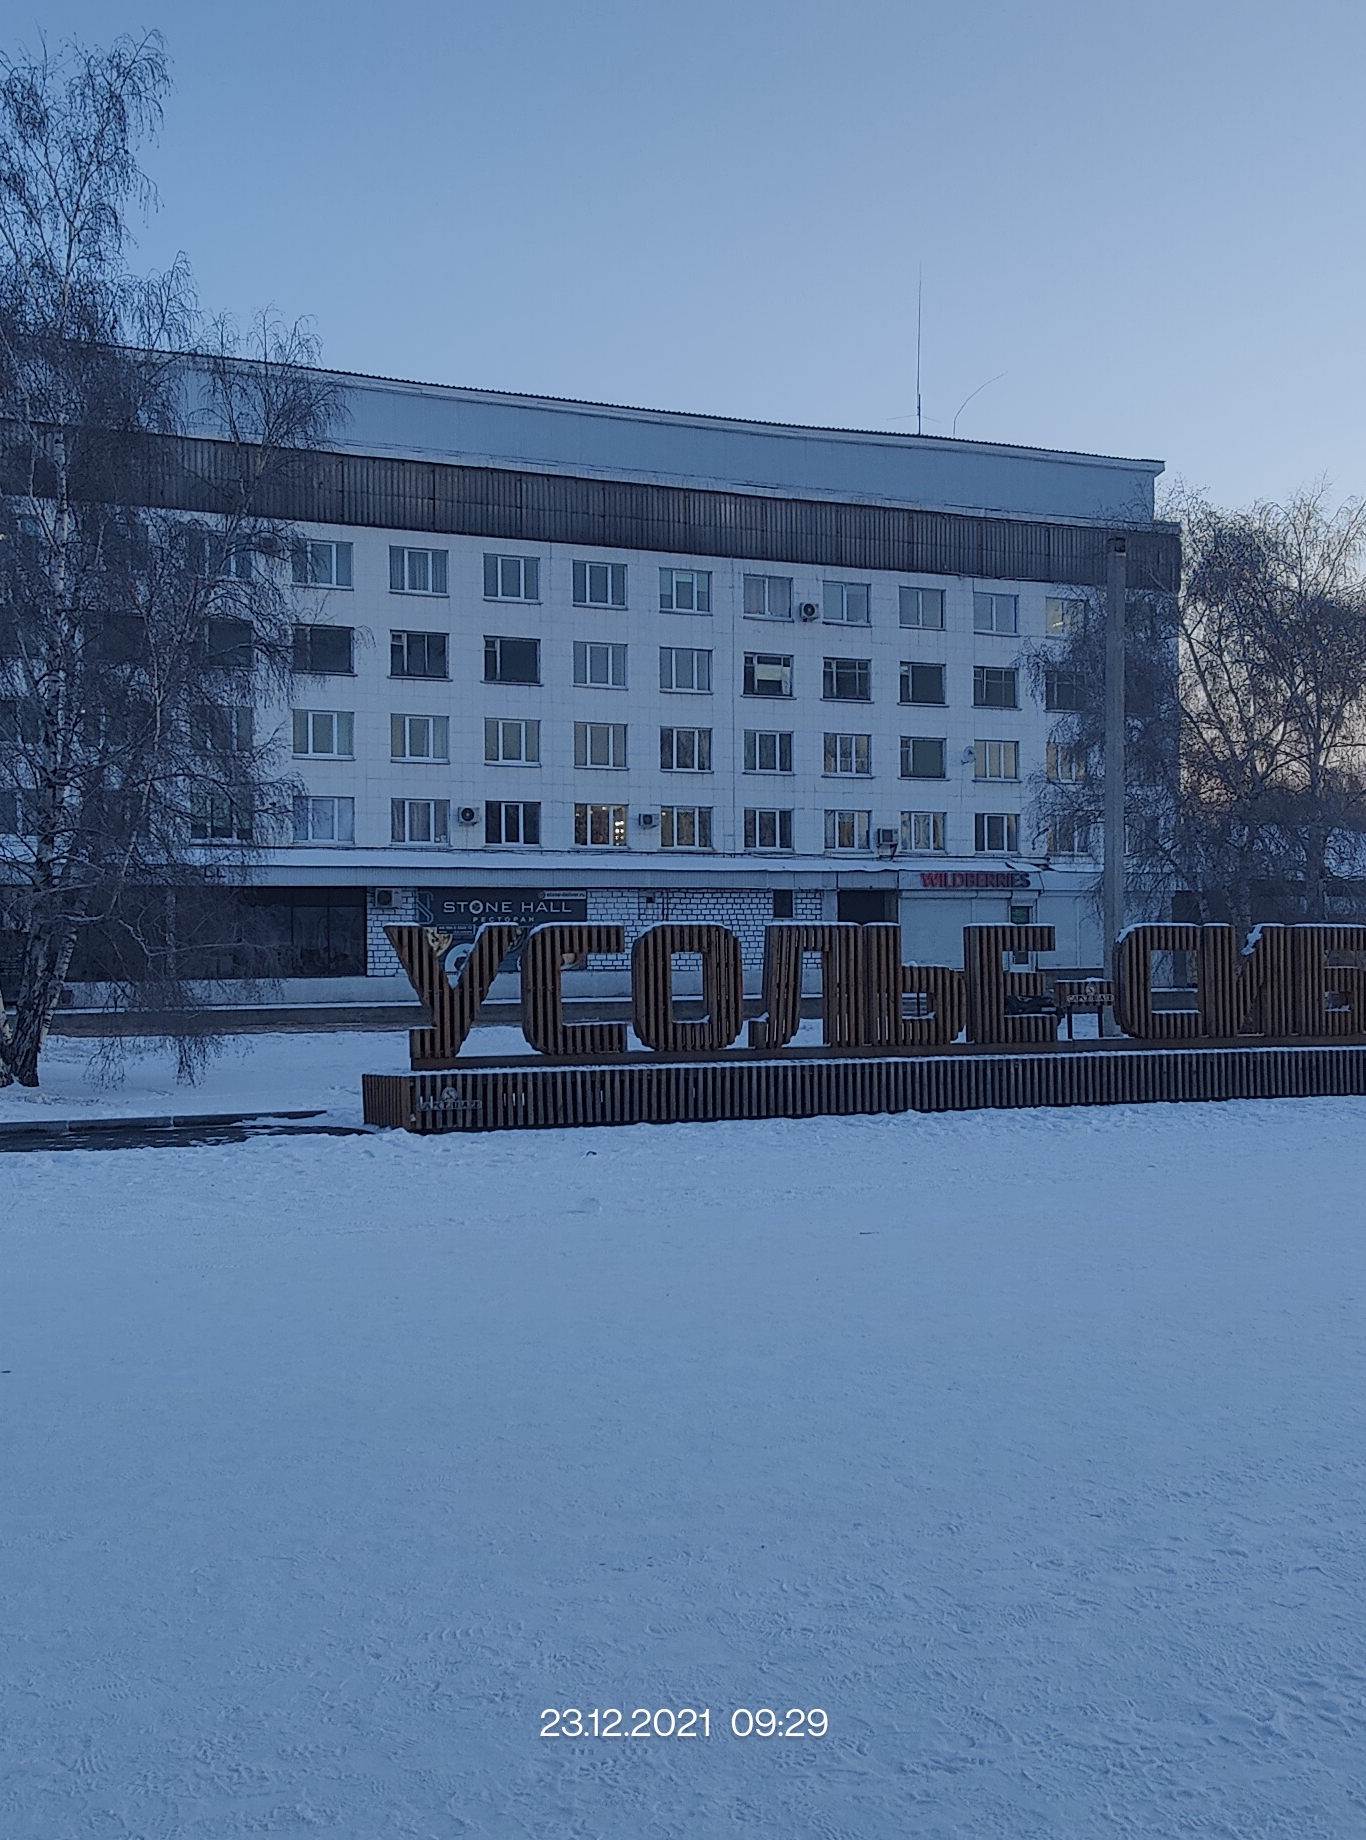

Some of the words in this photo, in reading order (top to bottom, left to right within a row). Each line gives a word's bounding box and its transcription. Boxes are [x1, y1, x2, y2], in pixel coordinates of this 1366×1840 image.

[920, 872, 1031, 888] WILDBERRIES
[443, 900, 512, 915] STONE
[521, 901, 572, 913] HALL
[385, 922, 1057, 1057] УСОЛЬЕ
